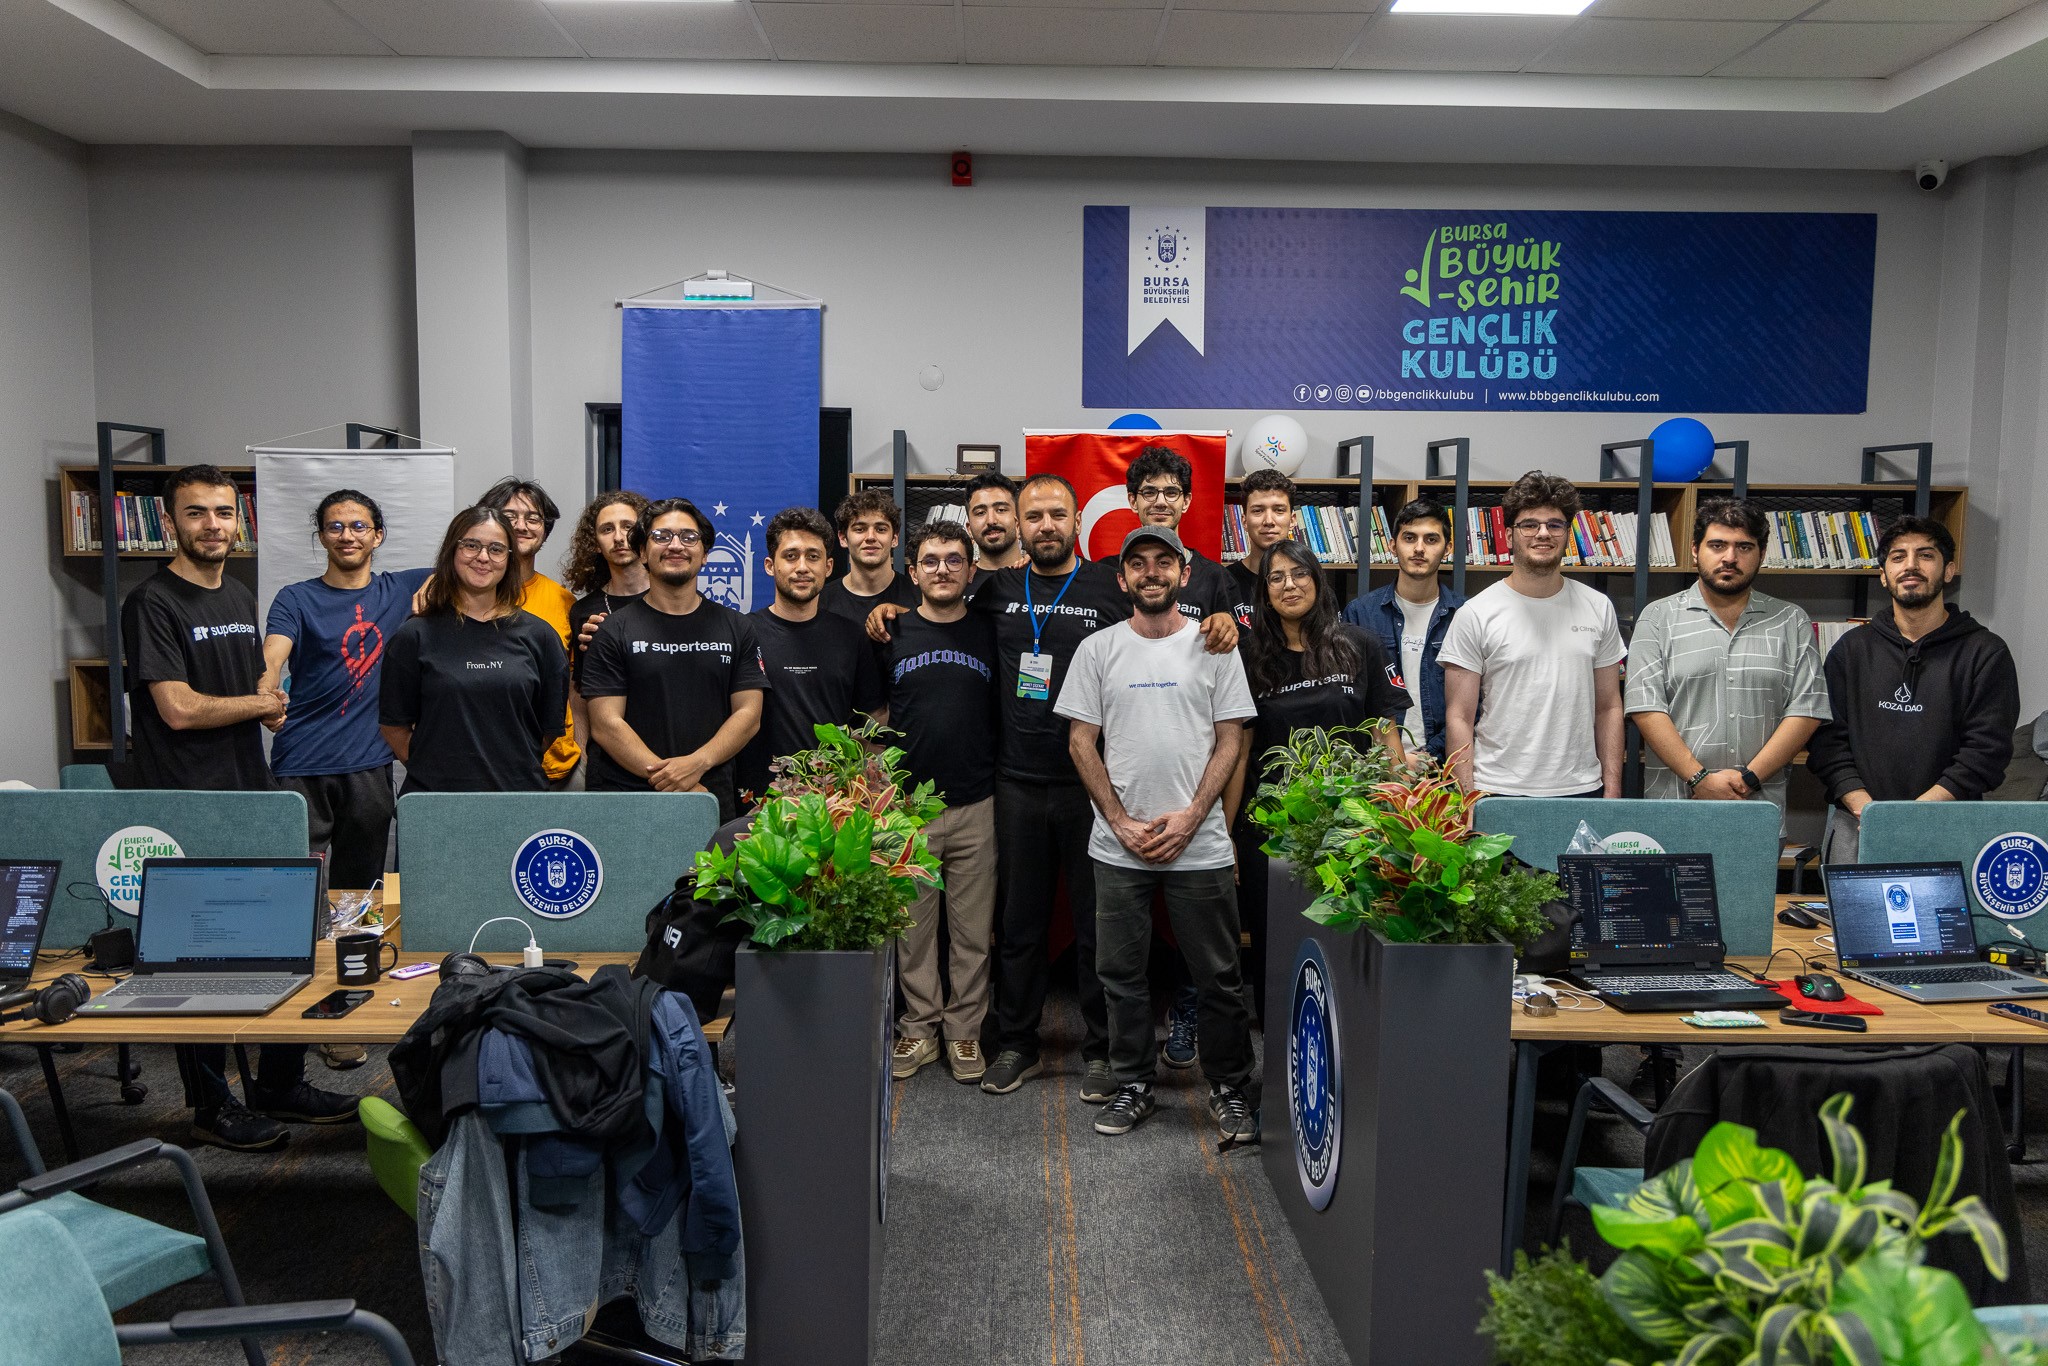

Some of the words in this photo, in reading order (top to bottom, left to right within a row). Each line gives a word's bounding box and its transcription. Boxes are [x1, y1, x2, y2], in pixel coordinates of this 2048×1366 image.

[1440, 222, 1507, 243] BURSA
[1439, 238, 1561, 278] BÜYÜK
[1143, 276, 1190, 287] BURSA
[1143, 286, 1190, 296] BÜYÜKŞEHİR
[1143, 295, 1190, 304] BELEDİYESİ
[1402, 309, 1558, 347] GENÇLİK
[1401, 348, 1558, 379] KULÜBÜ
[1374, 389, 1475, 401] /bbgenclikkulubu
[1498, 390, 1660, 402] www.bbbgenclikkulubu.com
[210, 622, 256, 637] supeteam
[1083, 619, 1097, 628] TR
[651, 641, 732, 654] superteam
[720, 654, 731, 664] TR
[1341, 685, 1354, 694] TR
[1878, 700, 1903, 711] KOZA
[1904, 704, 1922, 712] DAO
[124, 836, 153, 845] BURSA
[538, 835, 574, 848] BURSA
[2000, 838, 2034, 851] BURSA
[124, 842, 178, 859] BÜYÜK
[110, 888, 140, 901] KUL
[518, 871, 560, 913] BÜYÜKŞEHİR
[562, 869, 596, 912] BELEDİYESİ
[1979, 872, 2015, 913] BÜYÜKŞEHİR
[1305, 967, 1325, 1016] BURSA
